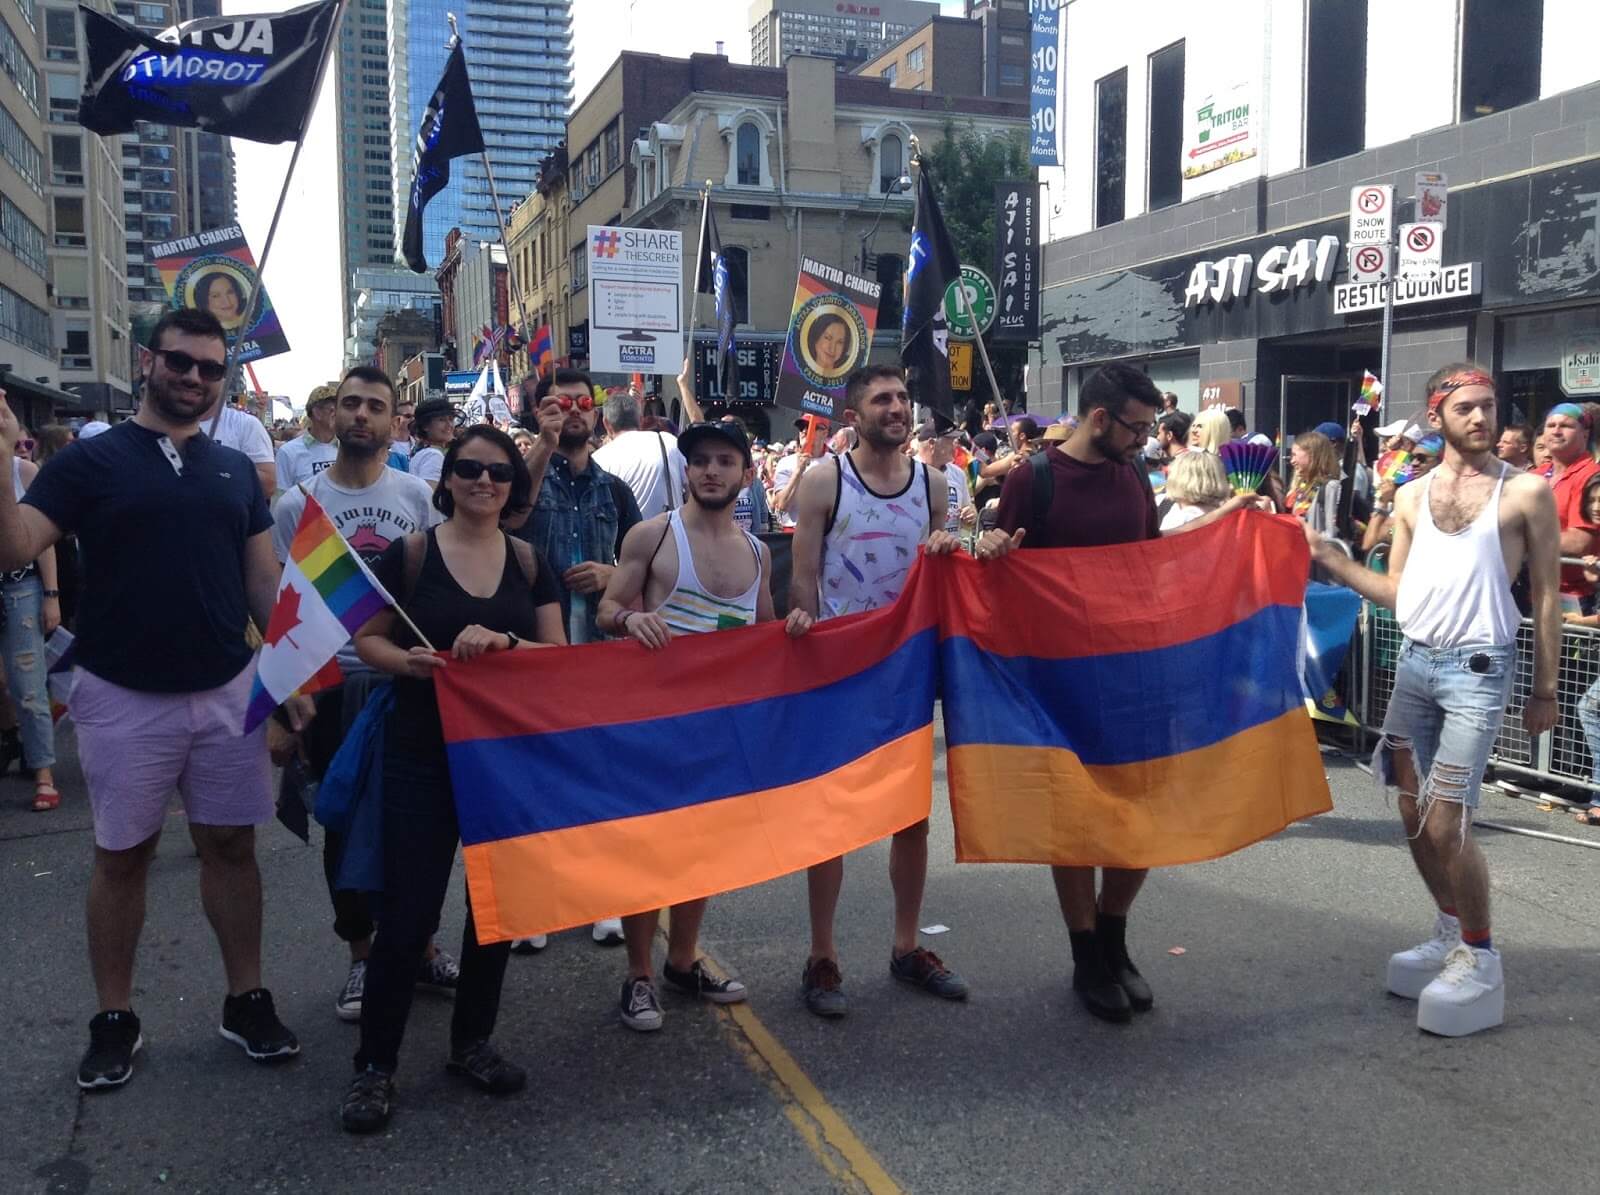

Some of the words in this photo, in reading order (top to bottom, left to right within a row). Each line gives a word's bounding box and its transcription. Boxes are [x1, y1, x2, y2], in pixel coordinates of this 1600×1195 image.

[1038, 13, 1053, 24] Per
[1032, 23, 1058, 35] Month
[1032, 45, 1057, 73] $10
[1036, 75, 1050, 86] Per
[1031, 84, 1057, 97] Month
[1031, 106, 1055, 134] $10
[1036, 136, 1050, 147] Per
[1030, 145, 1057, 157] Month
[1024, 196, 1033, 247] RESTO
[1356, 217, 1385, 228] SNOW
[151, 236, 200, 258] MARTHA
[199, 225, 242, 247] CHAVES
[623, 231, 679, 251] SHARE
[1353, 229, 1387, 240] ROUTE
[624, 250, 679, 263] THESCREEN
[802, 257, 844, 285] MARTHA
[844, 274, 881, 299] CHAVES
[1184, 253, 1253, 308] AJI
[1256, 234, 1340, 294] SAI
[1023, 252, 1033, 312] LOUNGE
[1394, 267, 1469, 300] LOUNGE
[621, 346, 654, 355] ACTRA
[706, 350, 757, 367] HSE
[802, 390, 834, 407] ACTRA
[1203, 386, 1221, 401] AJI
